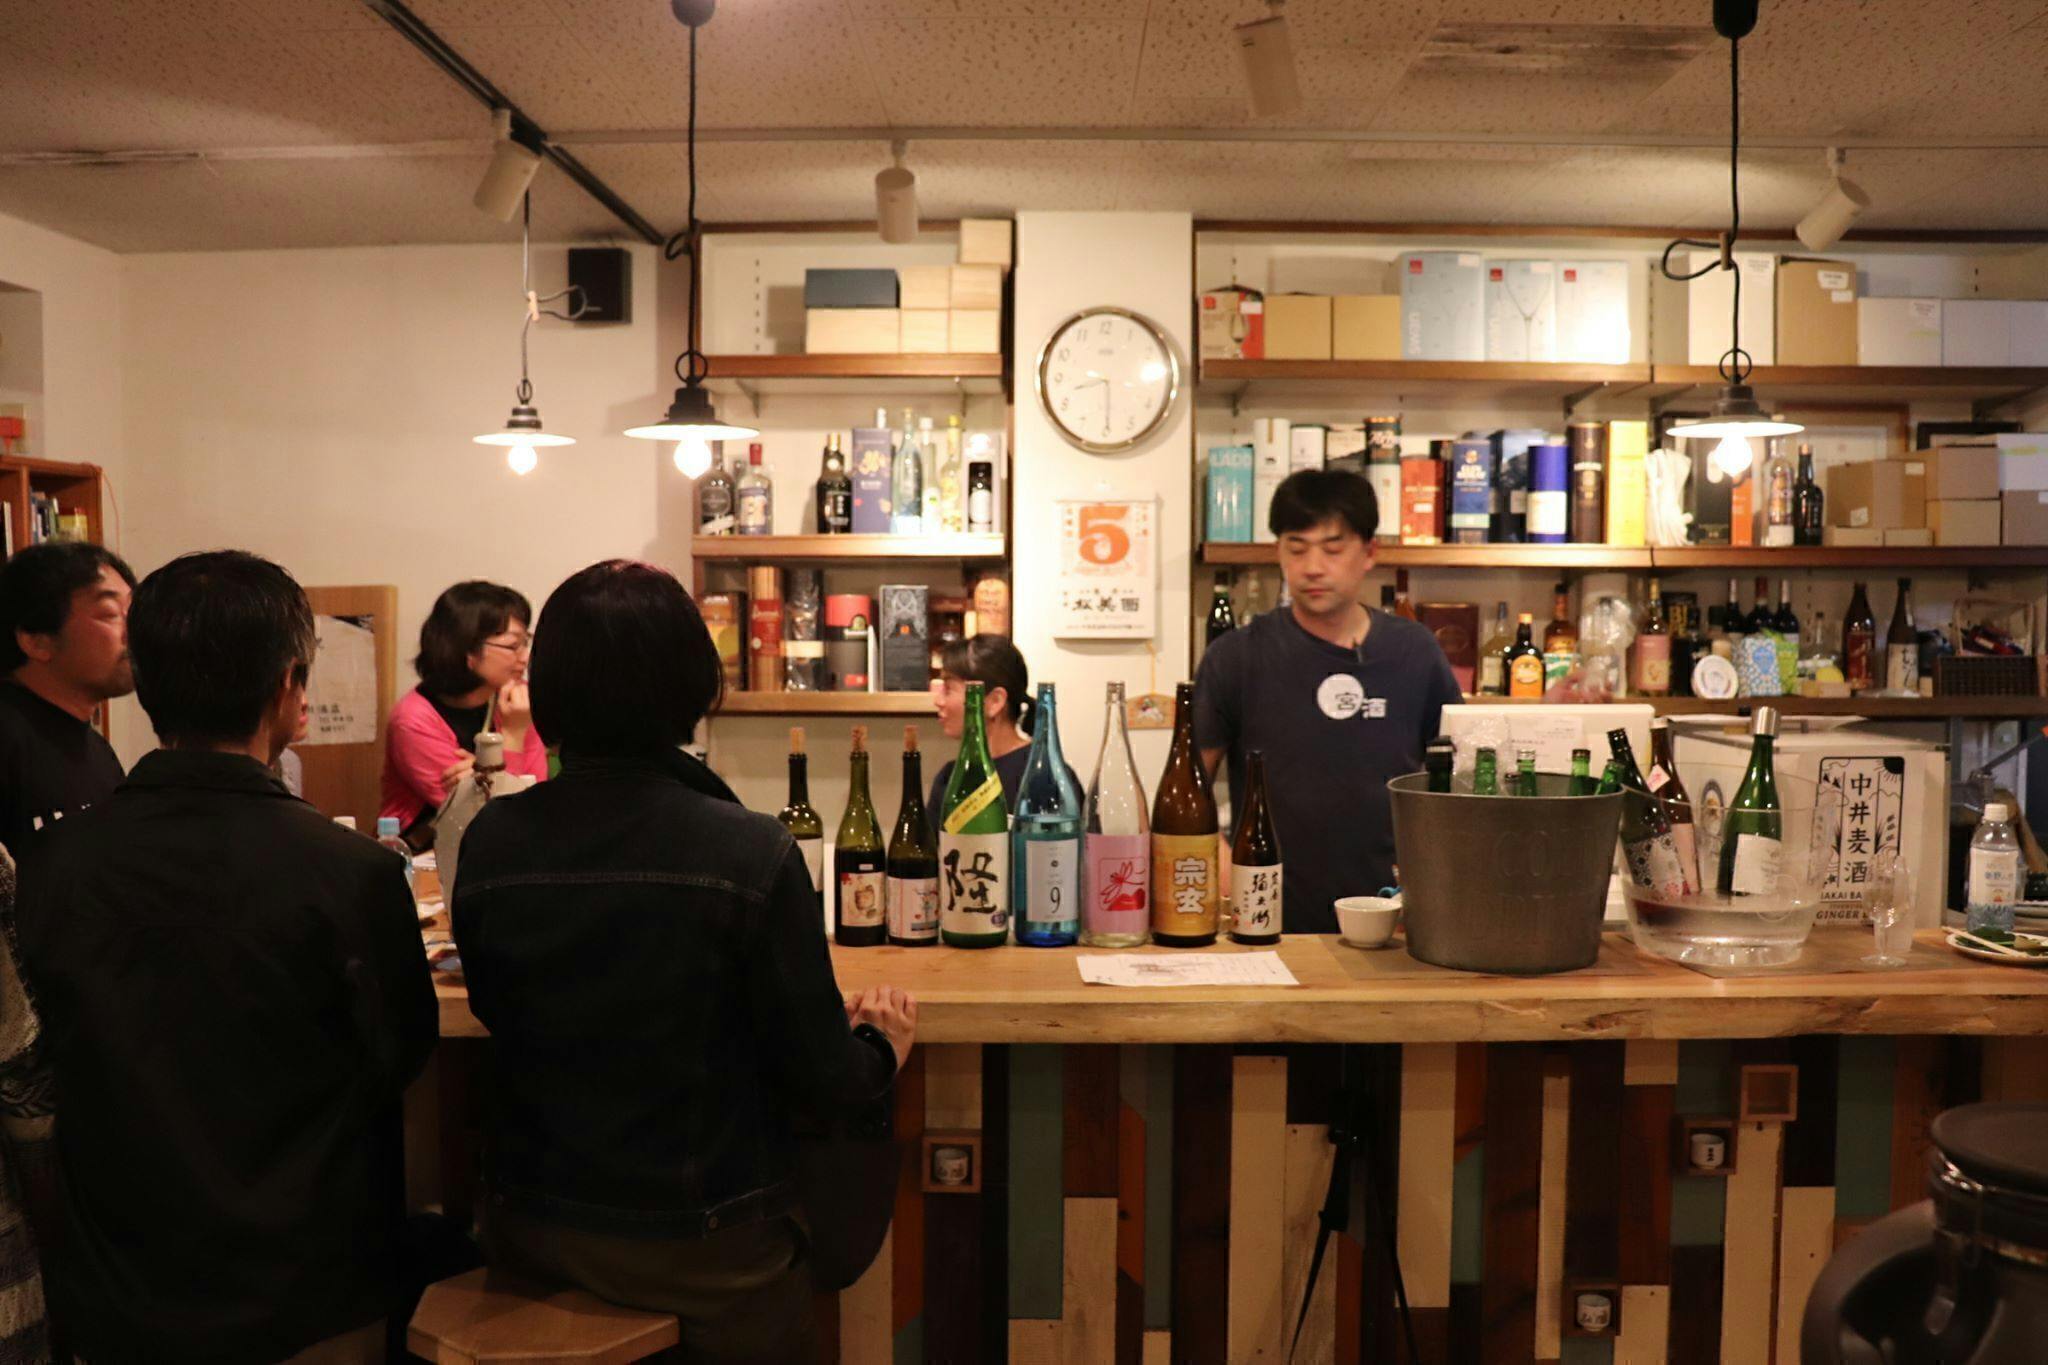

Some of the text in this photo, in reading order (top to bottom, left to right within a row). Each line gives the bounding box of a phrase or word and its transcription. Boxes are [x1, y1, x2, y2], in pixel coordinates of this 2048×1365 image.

[1100, 320, 1113, 335] 12
[1078, 503, 1130, 565] 5
[1844, 772, 1872, 884] 中井麦酒
[943, 848, 998, 914] 隆
[1050, 886, 1060, 914] 9
[1816, 910, 1859, 920] GINGER
